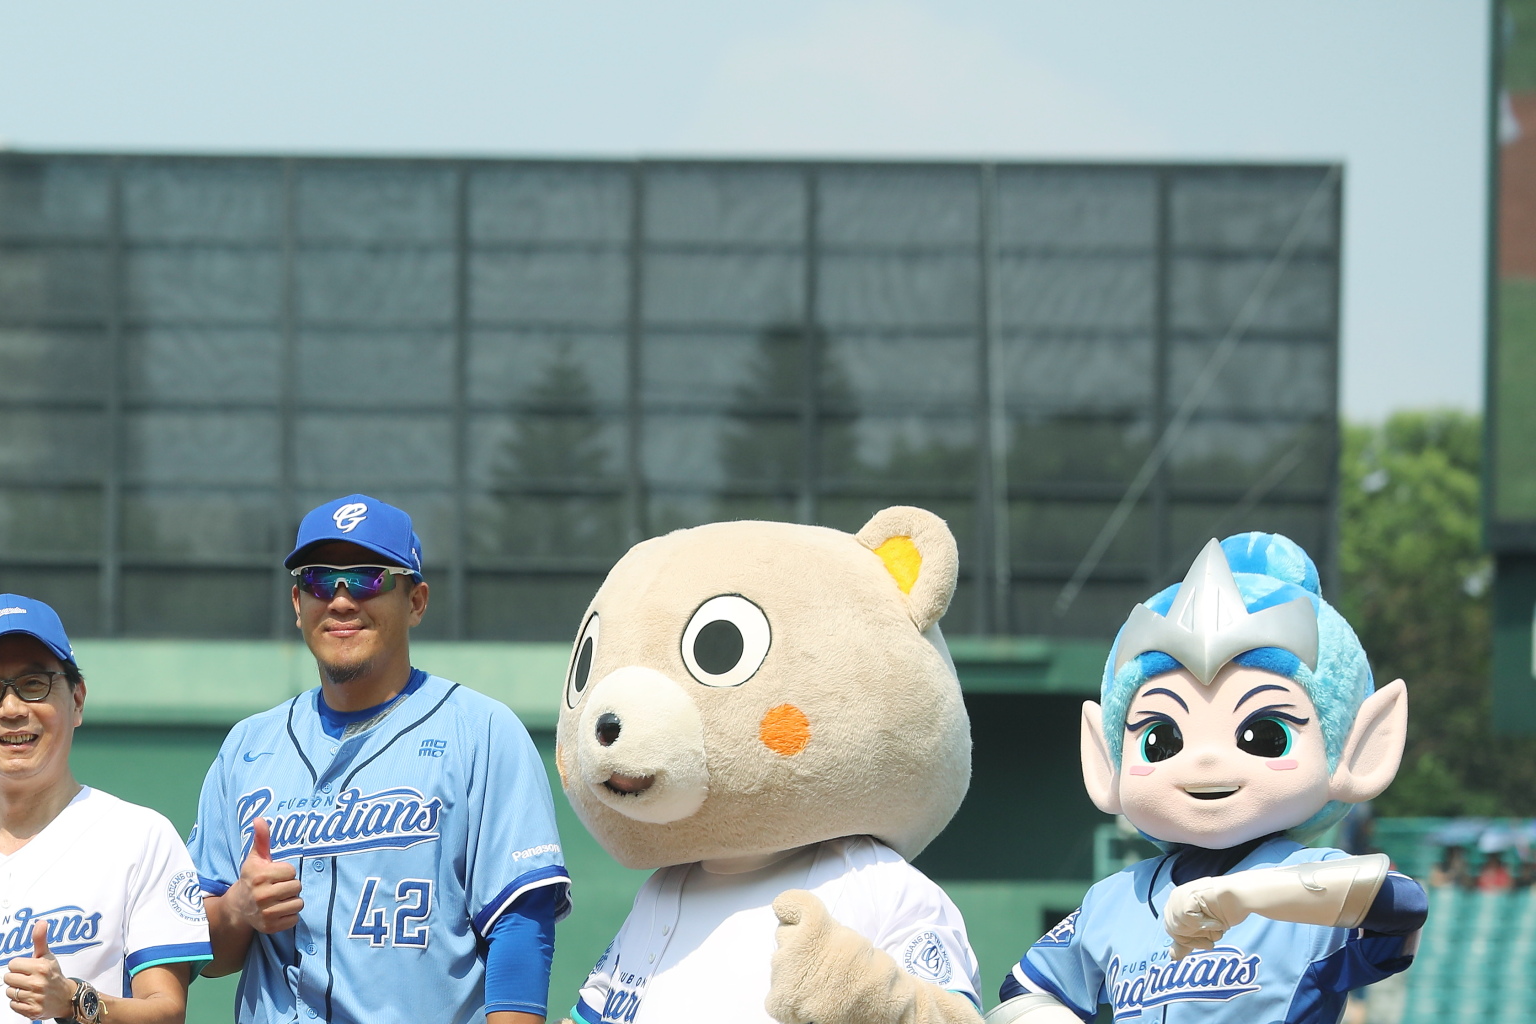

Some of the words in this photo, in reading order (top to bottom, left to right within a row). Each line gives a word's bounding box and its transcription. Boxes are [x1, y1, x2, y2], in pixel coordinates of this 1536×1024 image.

[237, 786, 443, 867] Guardians
[511, 843, 561, 861] Panason
[348, 876, 433, 948] 42
